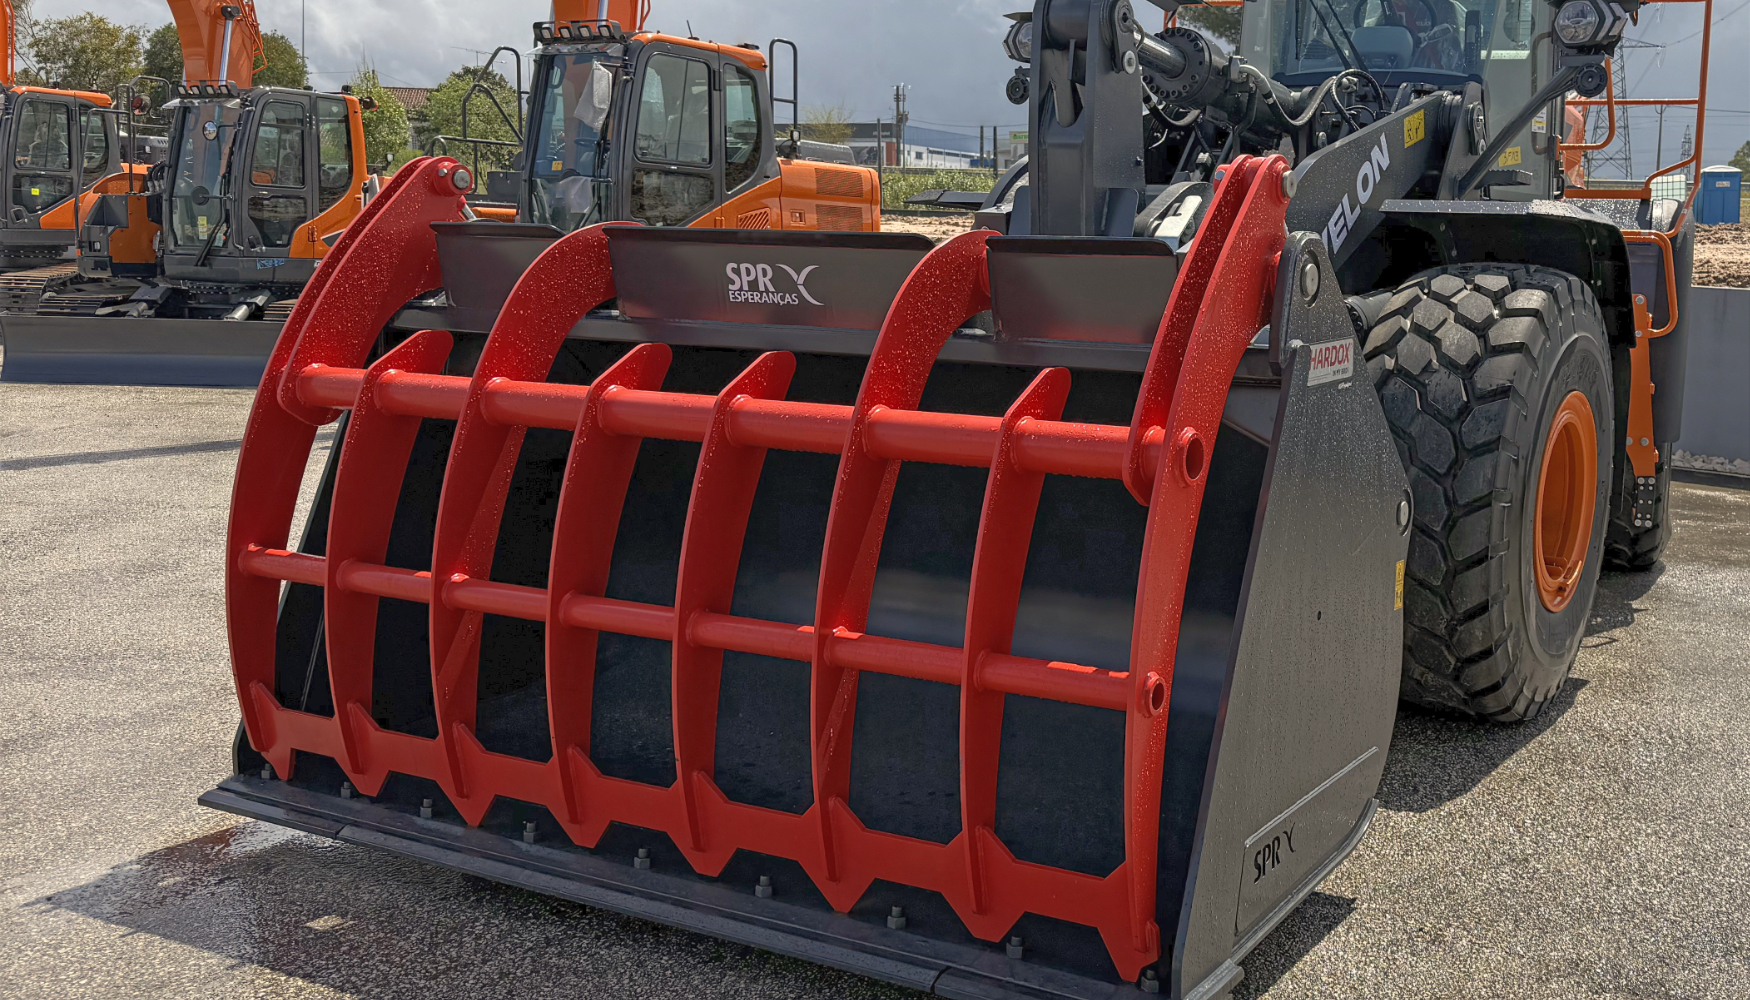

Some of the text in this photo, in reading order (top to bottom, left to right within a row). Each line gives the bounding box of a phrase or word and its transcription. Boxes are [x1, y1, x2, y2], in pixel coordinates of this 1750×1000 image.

[726, 262, 776, 292] SPR
[728, 291, 799, 306] ESPERANÇAS
[1309, 343, 1351, 370] HARDOX
[1253, 835, 1281, 884] SPR
